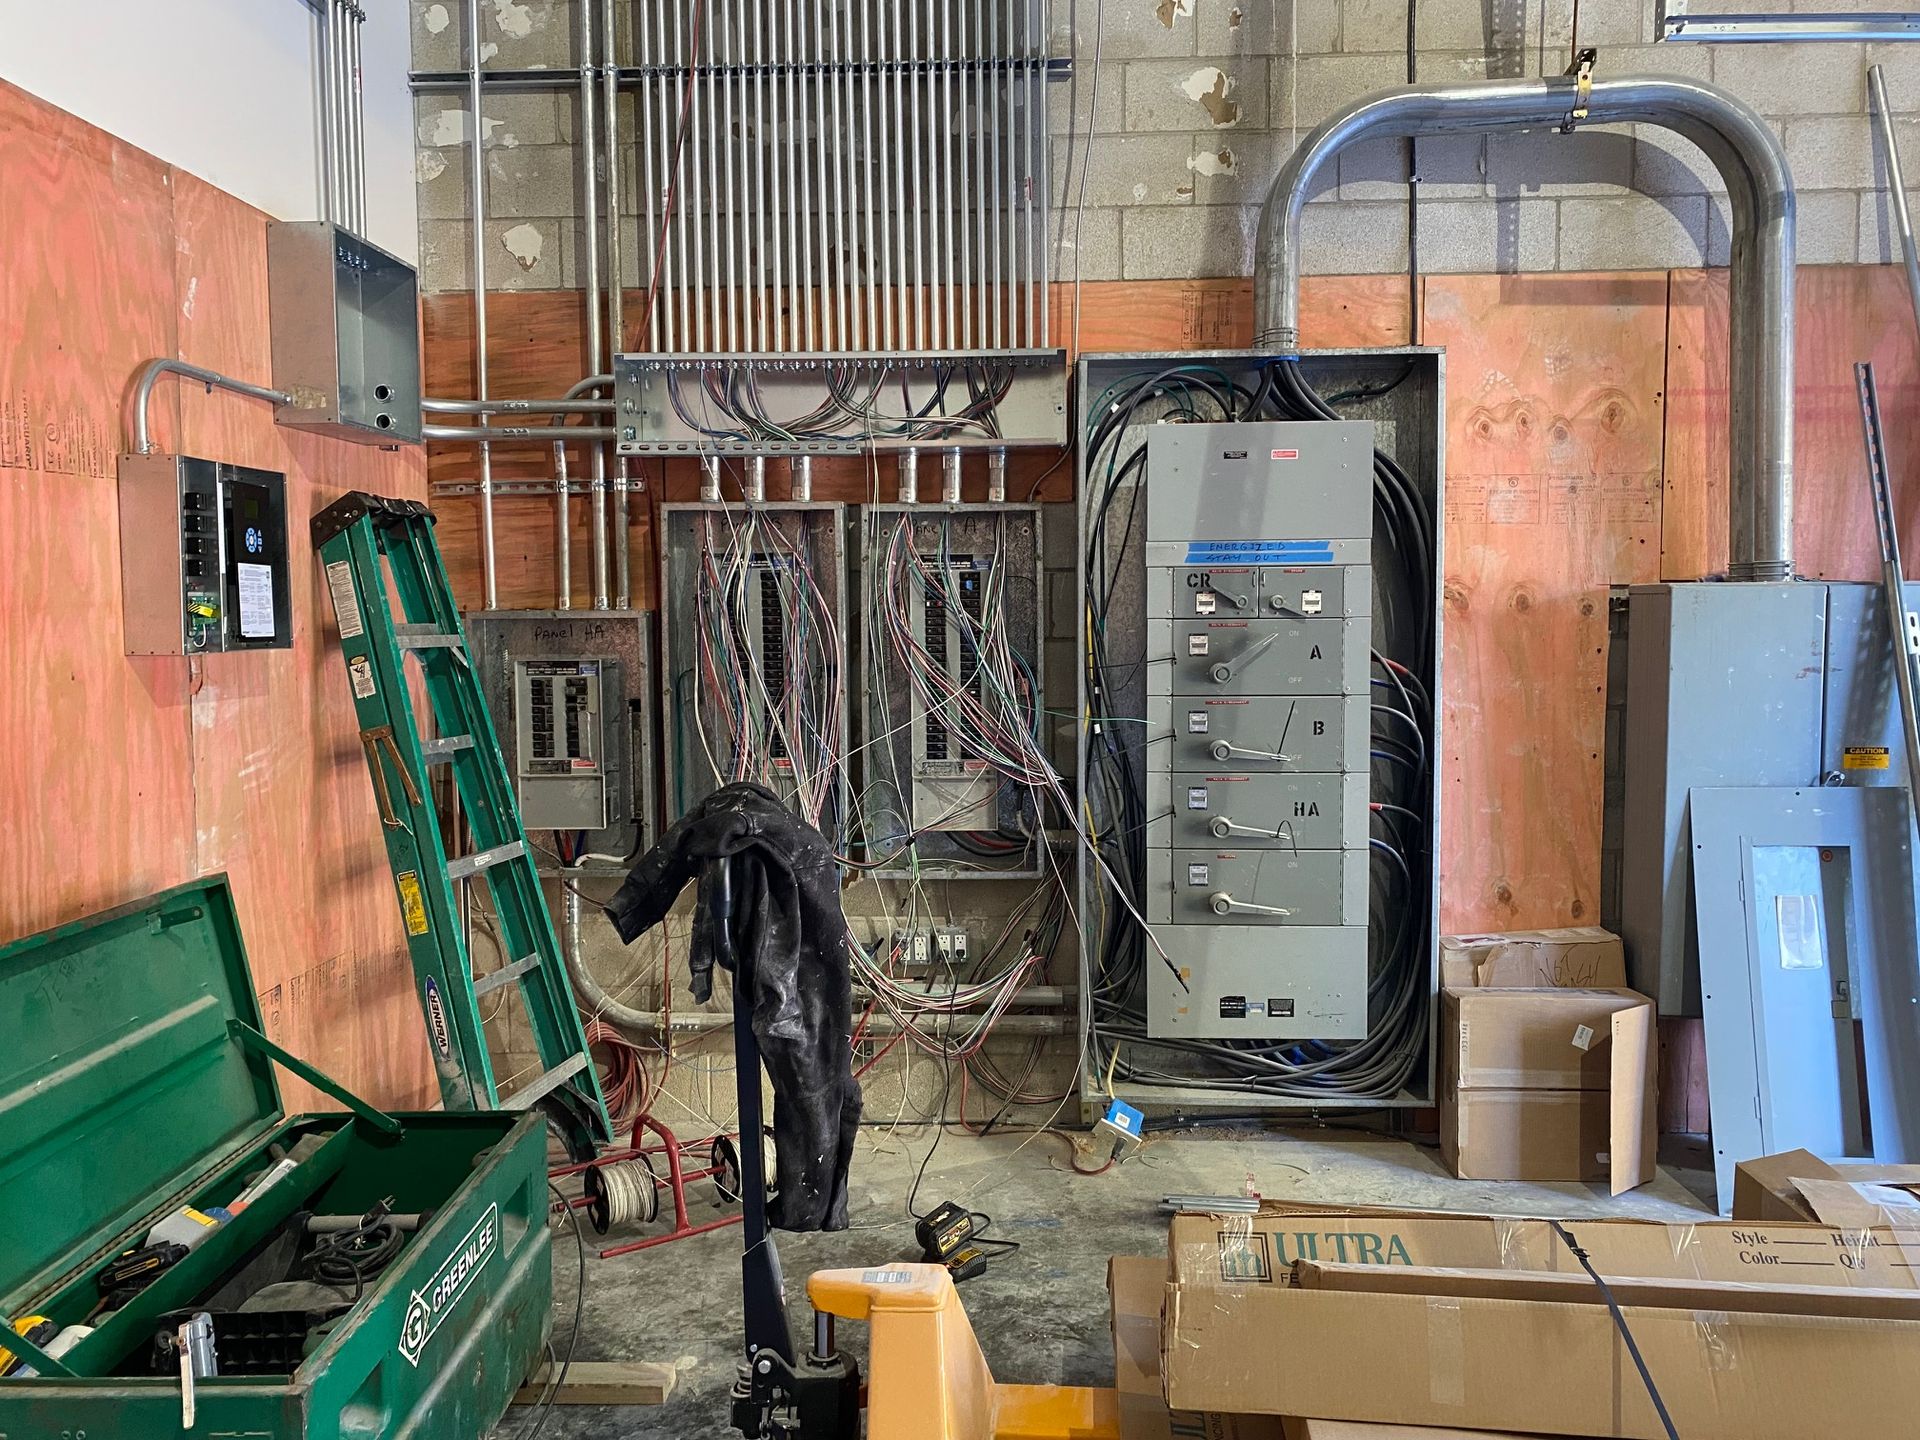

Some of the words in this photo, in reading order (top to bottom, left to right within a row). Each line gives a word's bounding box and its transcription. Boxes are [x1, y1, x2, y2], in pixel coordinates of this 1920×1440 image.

[1209, 542, 1286, 551] ENERGIZED
[1187, 573, 1211, 588] CR
[585, 624, 605, 640] HA
[1310, 645, 1322, 660] A
[1287, 676, 1303, 684] OFF
[1313, 720, 1325, 735] B
[1294, 801, 1320, 817] HA
[430, 994, 447, 1048] WERNER
[1732, 1230, 1768, 1247] Style
[1272, 1231, 1414, 1268] ULTRA
[1739, 1250, 1780, 1265] Color
[432, 1221, 494, 1314] GREENLEE
